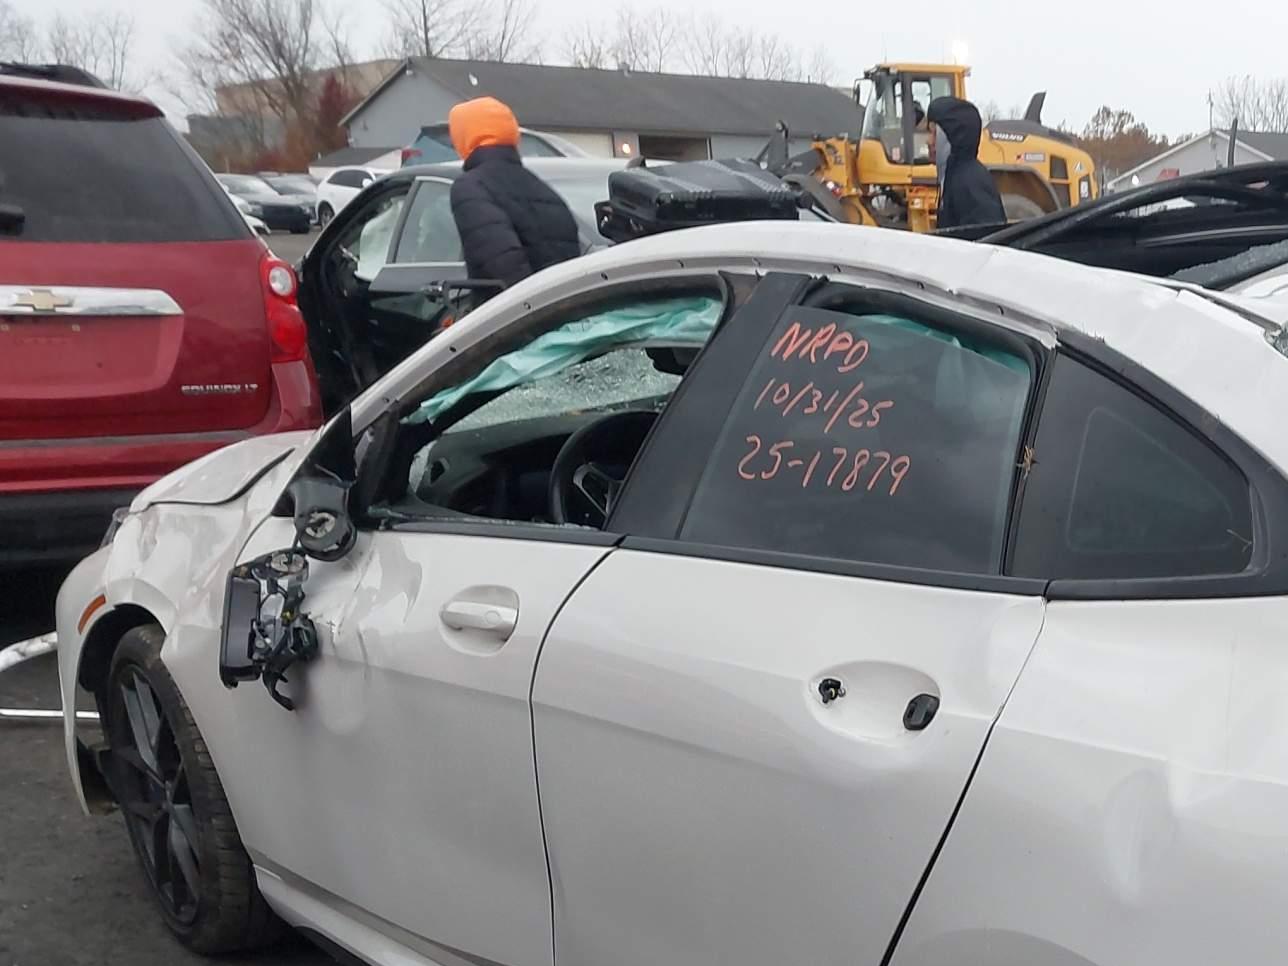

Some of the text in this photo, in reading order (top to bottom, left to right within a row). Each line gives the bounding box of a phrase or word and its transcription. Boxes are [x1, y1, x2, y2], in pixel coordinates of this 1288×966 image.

[770, 322, 870, 373] NRPD
[754, 378, 894, 434] 10/31/25
[738, 435, 910, 496] 25-17879
